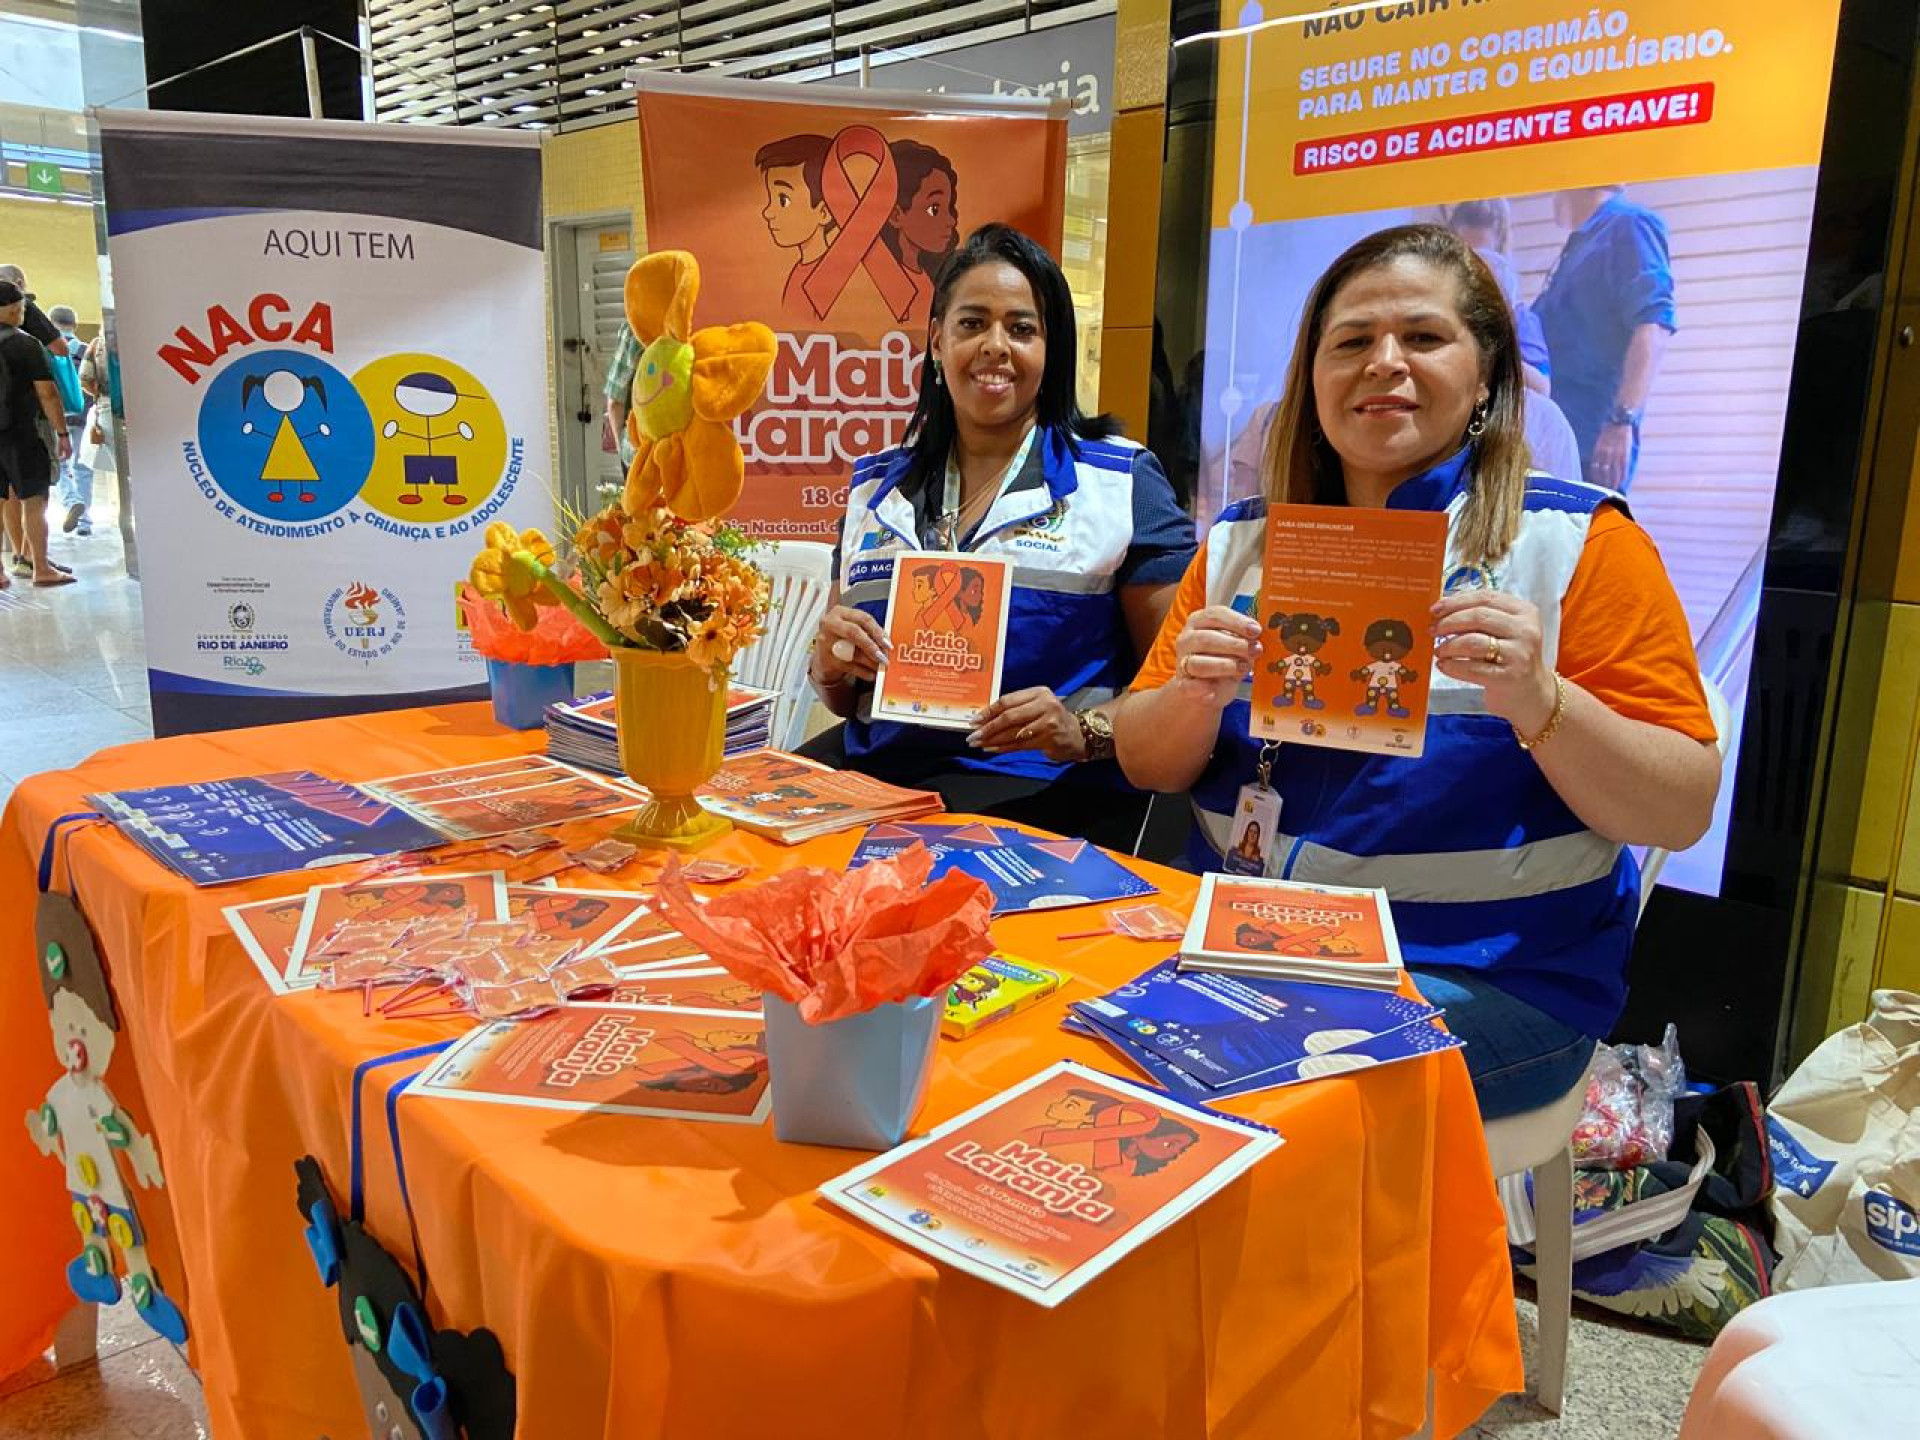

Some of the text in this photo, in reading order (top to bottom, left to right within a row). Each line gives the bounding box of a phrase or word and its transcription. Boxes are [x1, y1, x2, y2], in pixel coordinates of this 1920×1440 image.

[1299, 9, 1629, 91] SEGURE NO CORRIMÃO
[1299, 28, 1735, 120] PARA MANTER O EQUILÍBRIO.
[1303, 91, 1700, 169] RISCO DE ACIDENTE GRAVE!
[263, 229, 416, 260] AQUI TEM
[158, 293, 334, 385] NACA
[215, 499, 236, 518] DE
[237, 514, 346, 538] ATENDIMENTO
[347, 509, 361, 523] À
[364, 512, 431, 541] CRIANÇA
[435, 527, 446, 538] E
[449, 521, 469, 537] AO
[473, 437, 524, 527] ADOLESCENTE
[803, 486, 829, 507] 18
[750, 518, 826, 535] Nacional
[1016, 540, 1061, 552] SOCIAL
[872, 563, 893, 573] NAC
[197, 641, 289, 650] RIO DE JANEIRO
[345, 626, 386, 637] UERJ
[915, 630, 968, 650] Maio
[898, 644, 981, 671] Laranja
[547, 1013, 637, 1087] Laranja
[593, 1027, 655, 1075] Maio
[945, 1140, 1115, 1222] Laranja
[994, 1140, 1102, 1194] Maio
[1867, 1200, 1920, 1240] sip
